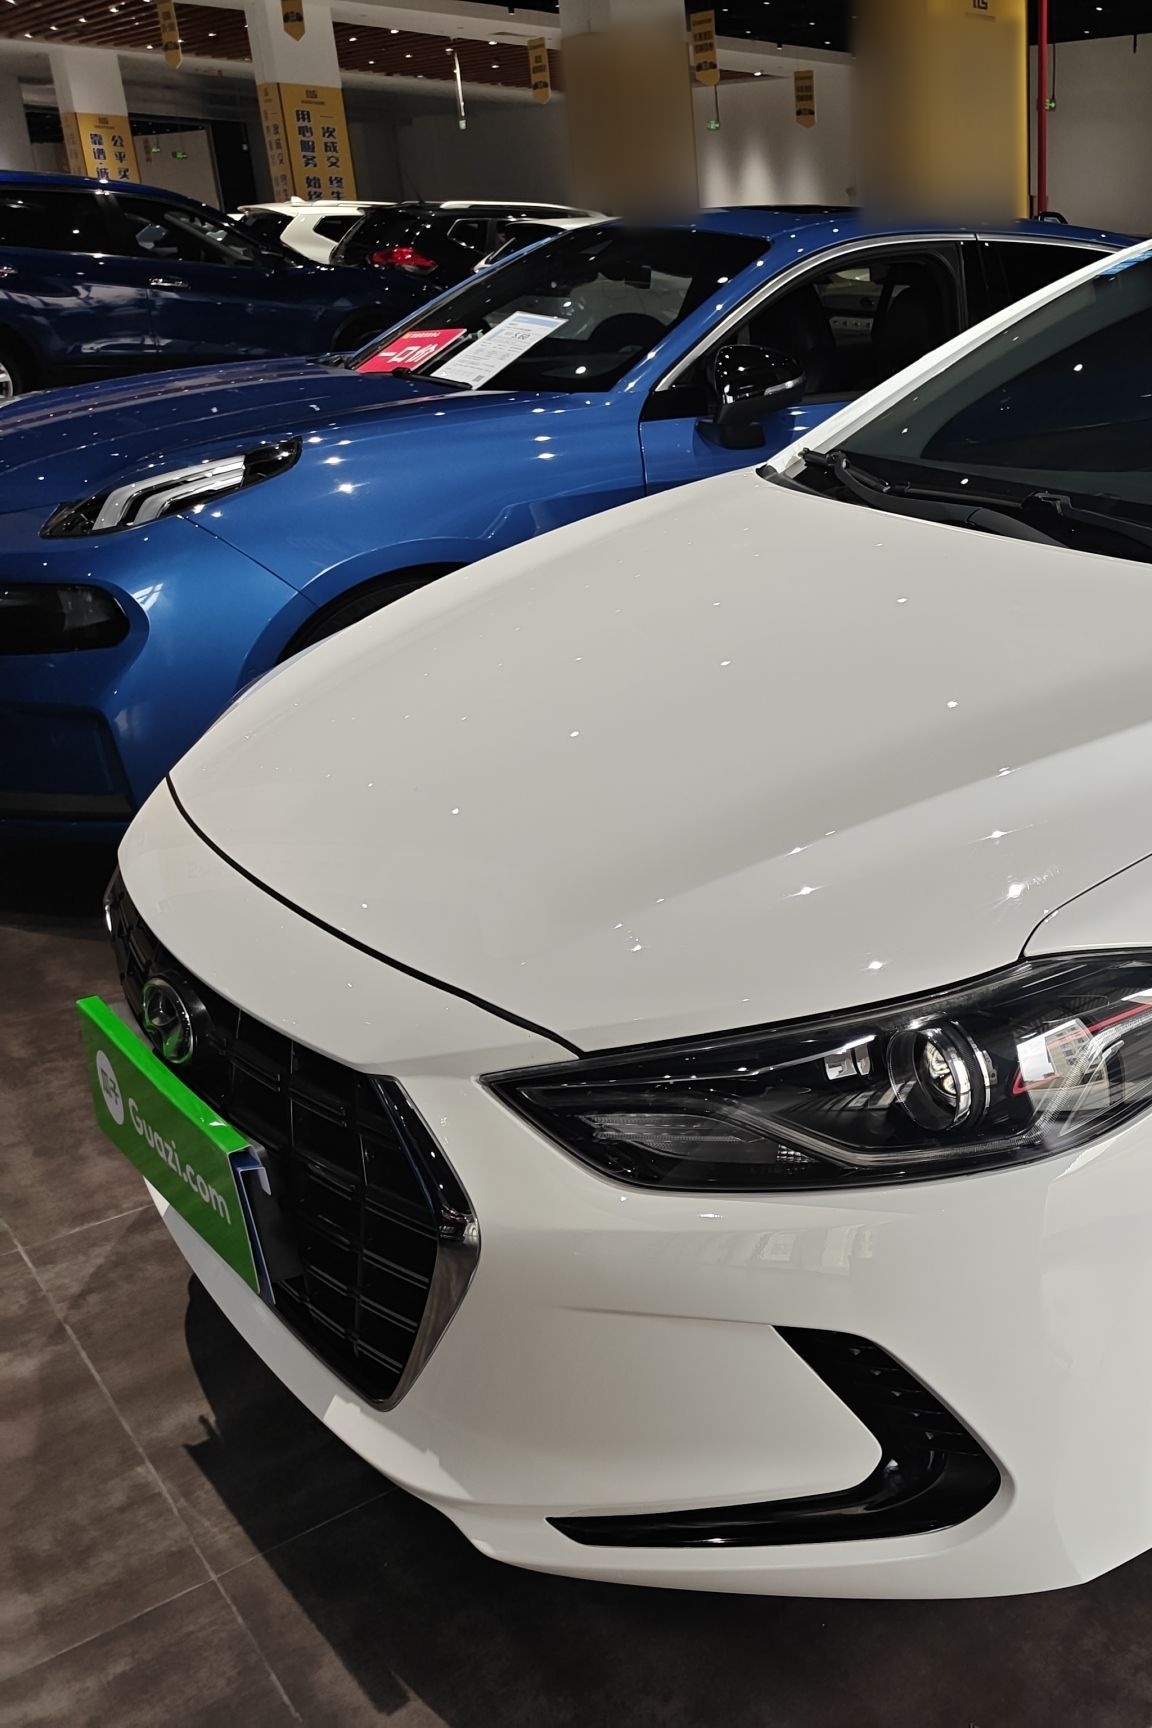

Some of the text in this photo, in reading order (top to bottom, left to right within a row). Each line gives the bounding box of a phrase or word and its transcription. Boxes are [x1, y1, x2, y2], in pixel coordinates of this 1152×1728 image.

[295, 109, 317, 168] 用心服务
[320, 115, 340, 168] 一次成交
[379, 343, 438, 363] 一口价
[128, 1098, 233, 1225] Guazi.com
